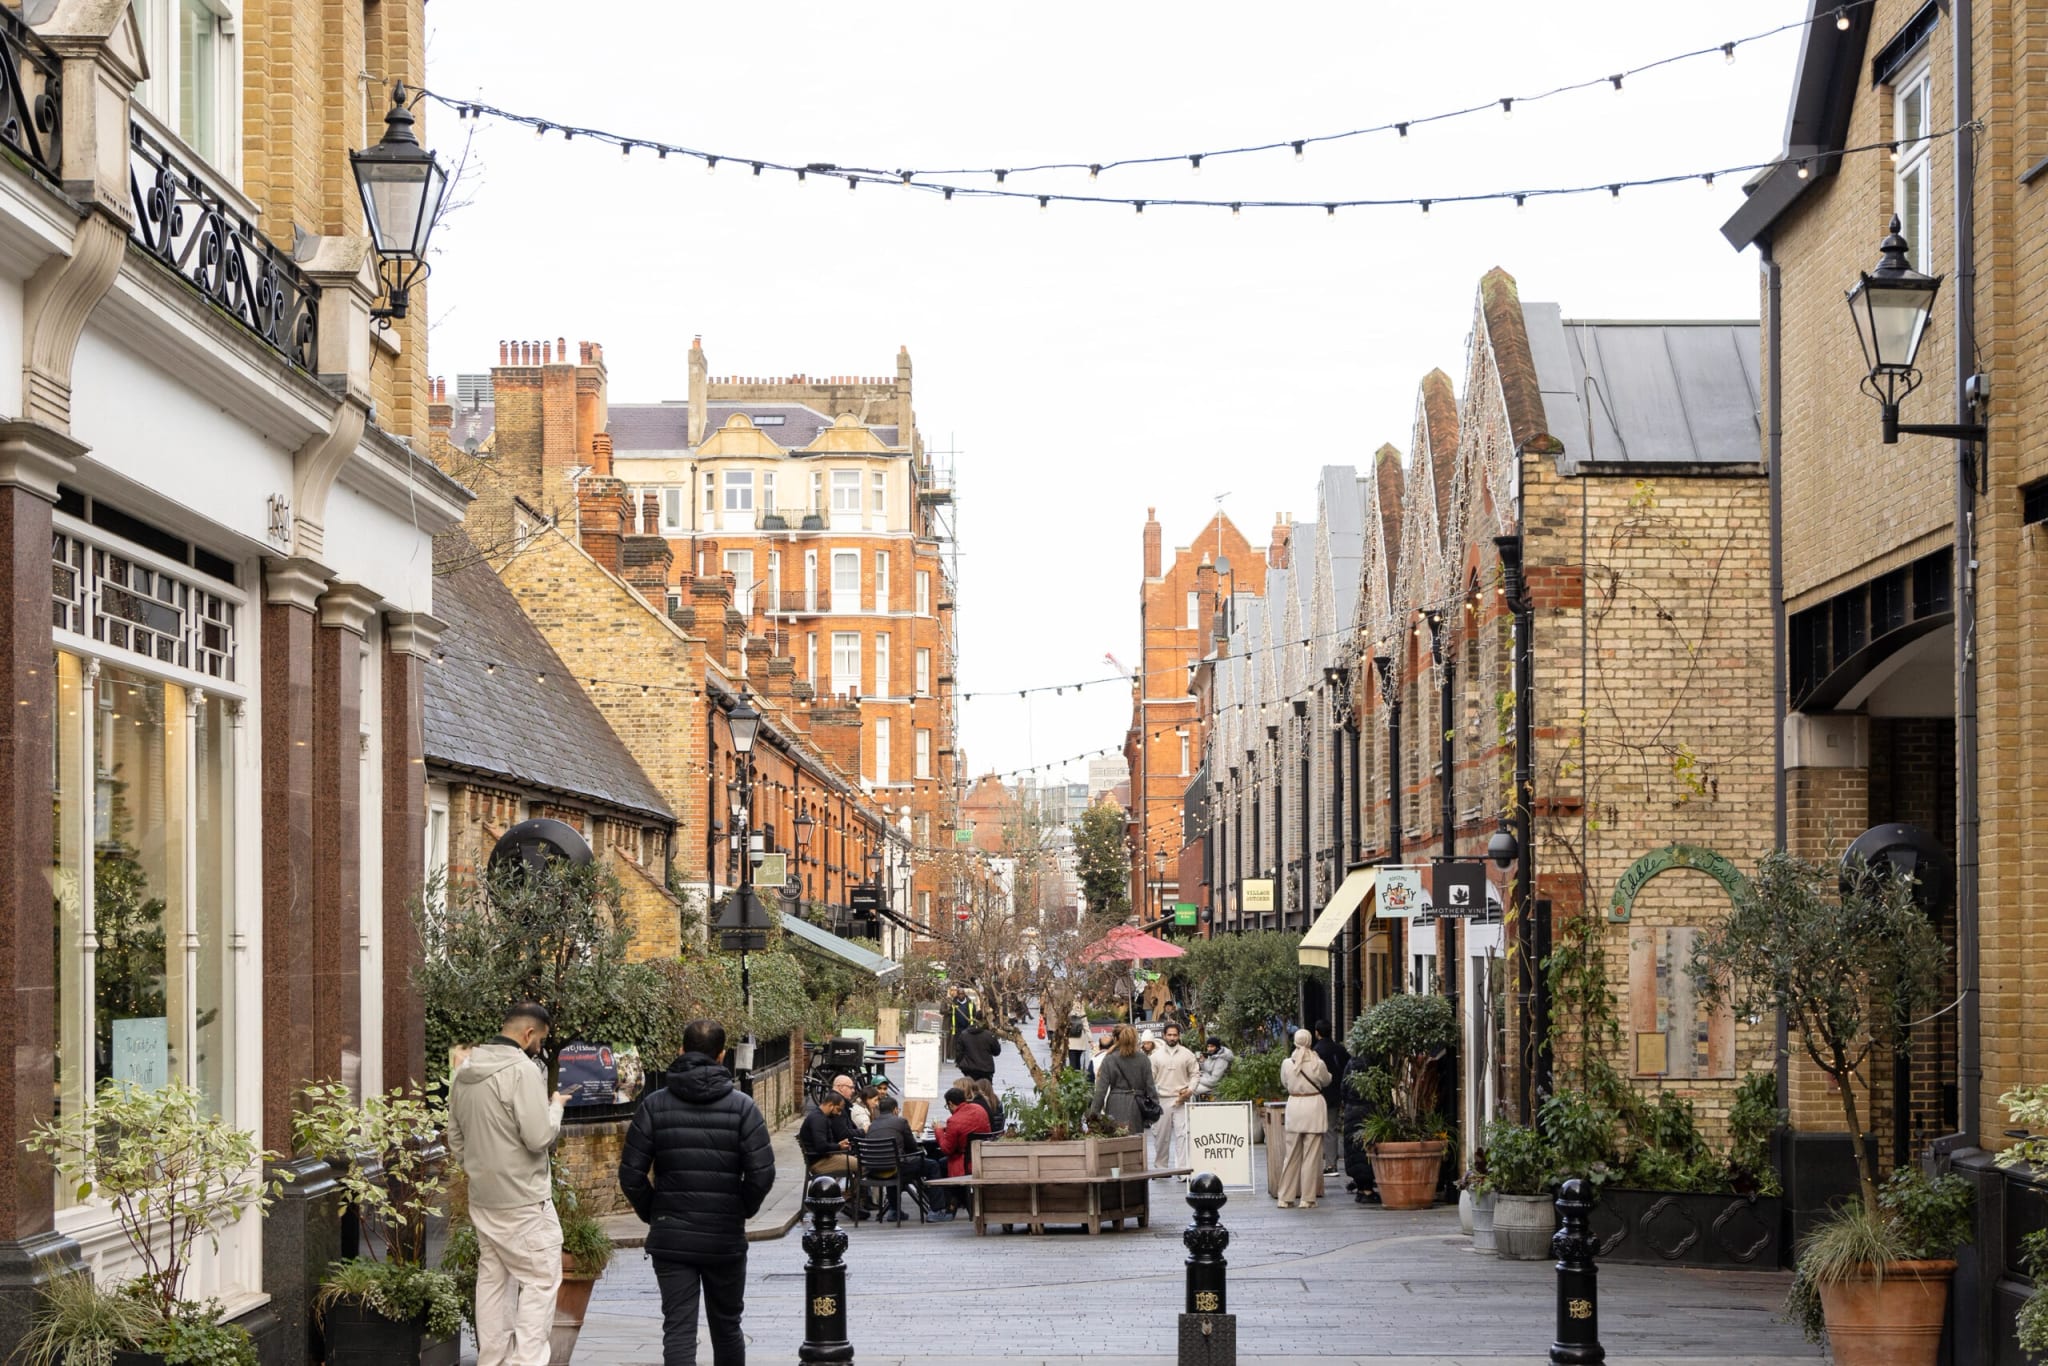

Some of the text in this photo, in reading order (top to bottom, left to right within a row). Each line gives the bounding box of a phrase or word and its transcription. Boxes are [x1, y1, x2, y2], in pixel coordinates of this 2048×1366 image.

[1620, 853, 1738, 899] Edible Trail
[1194, 1132, 1245, 1149] ROASTING
[1204, 1147, 1236, 1159] PARTY
